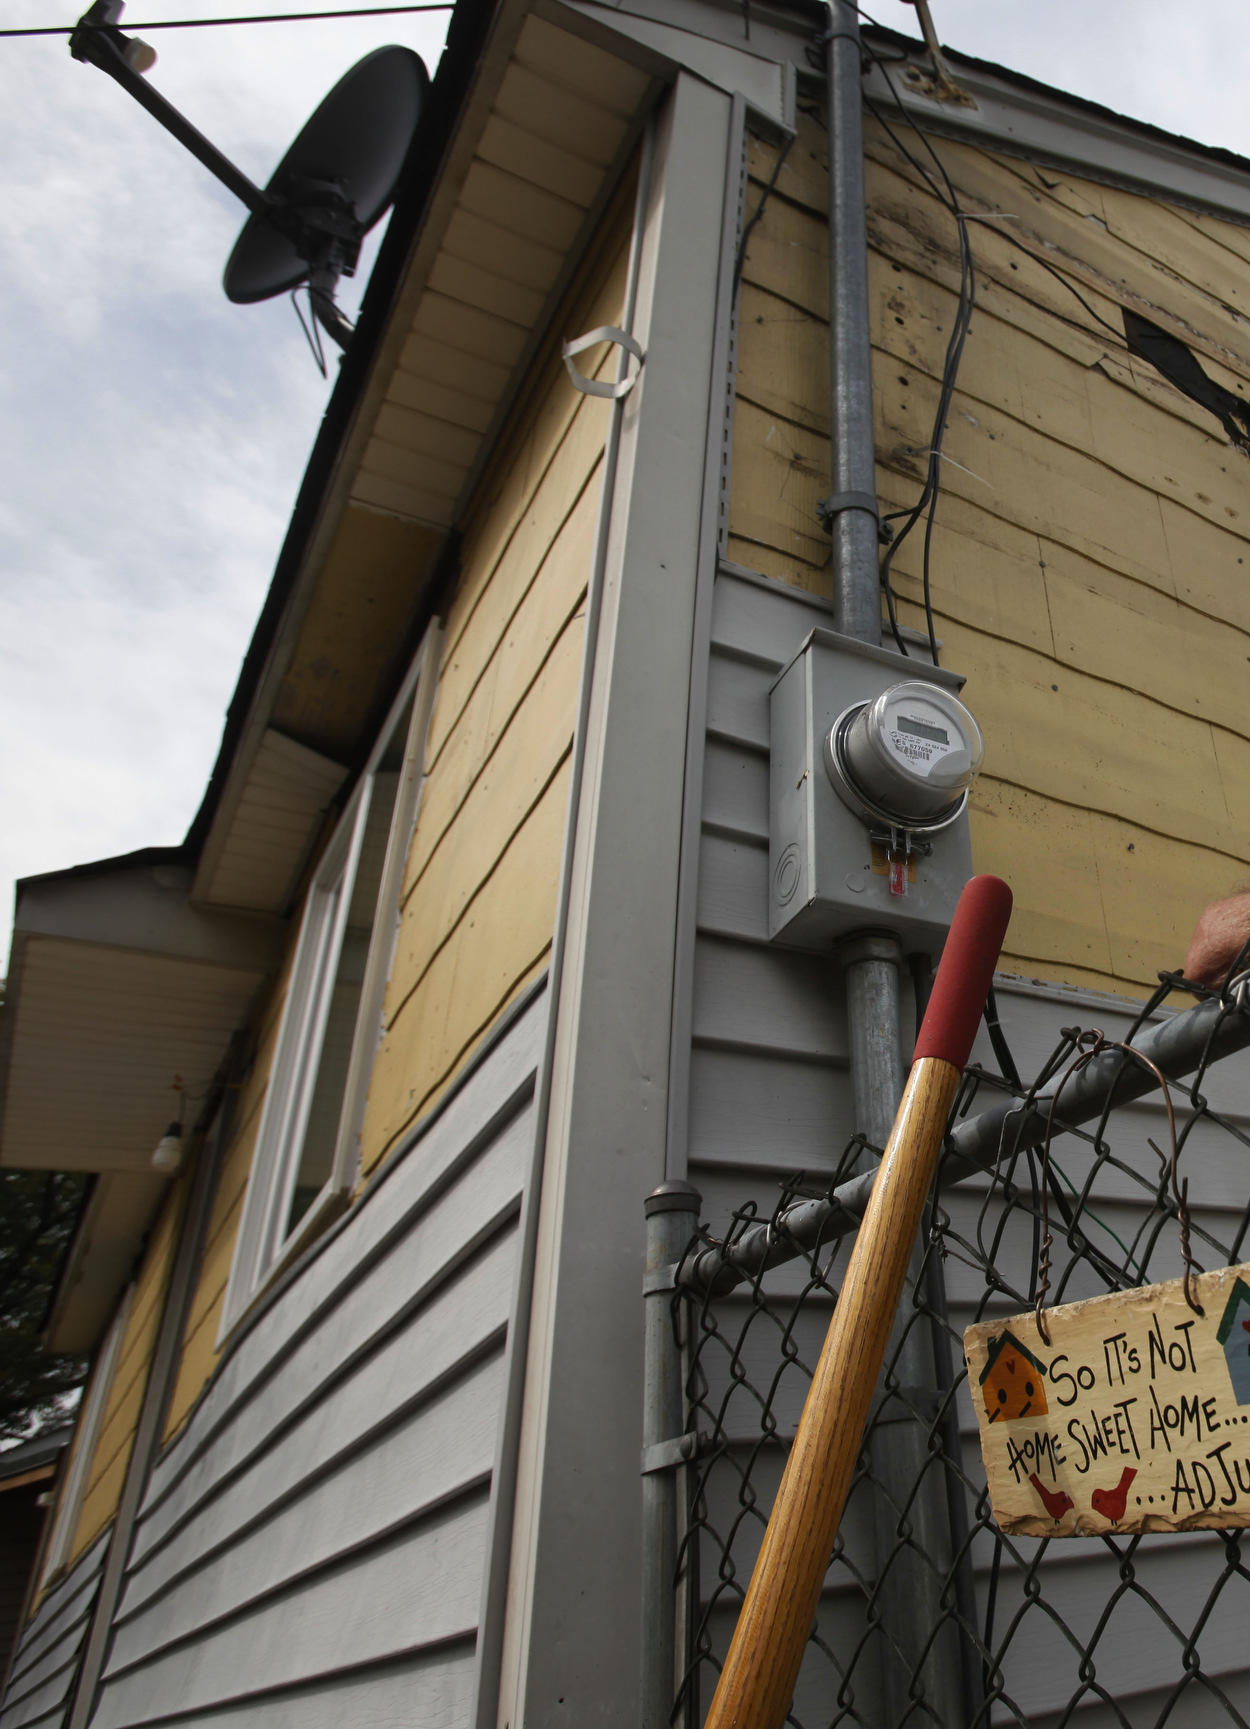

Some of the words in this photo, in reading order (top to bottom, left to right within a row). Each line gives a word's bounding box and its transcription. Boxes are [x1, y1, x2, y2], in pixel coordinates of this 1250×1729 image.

[1148, 1312, 1197, 1380] NOT
[1006, 1431, 1067, 1484] HOME
[1067, 1397, 1141, 1474] SWEET
